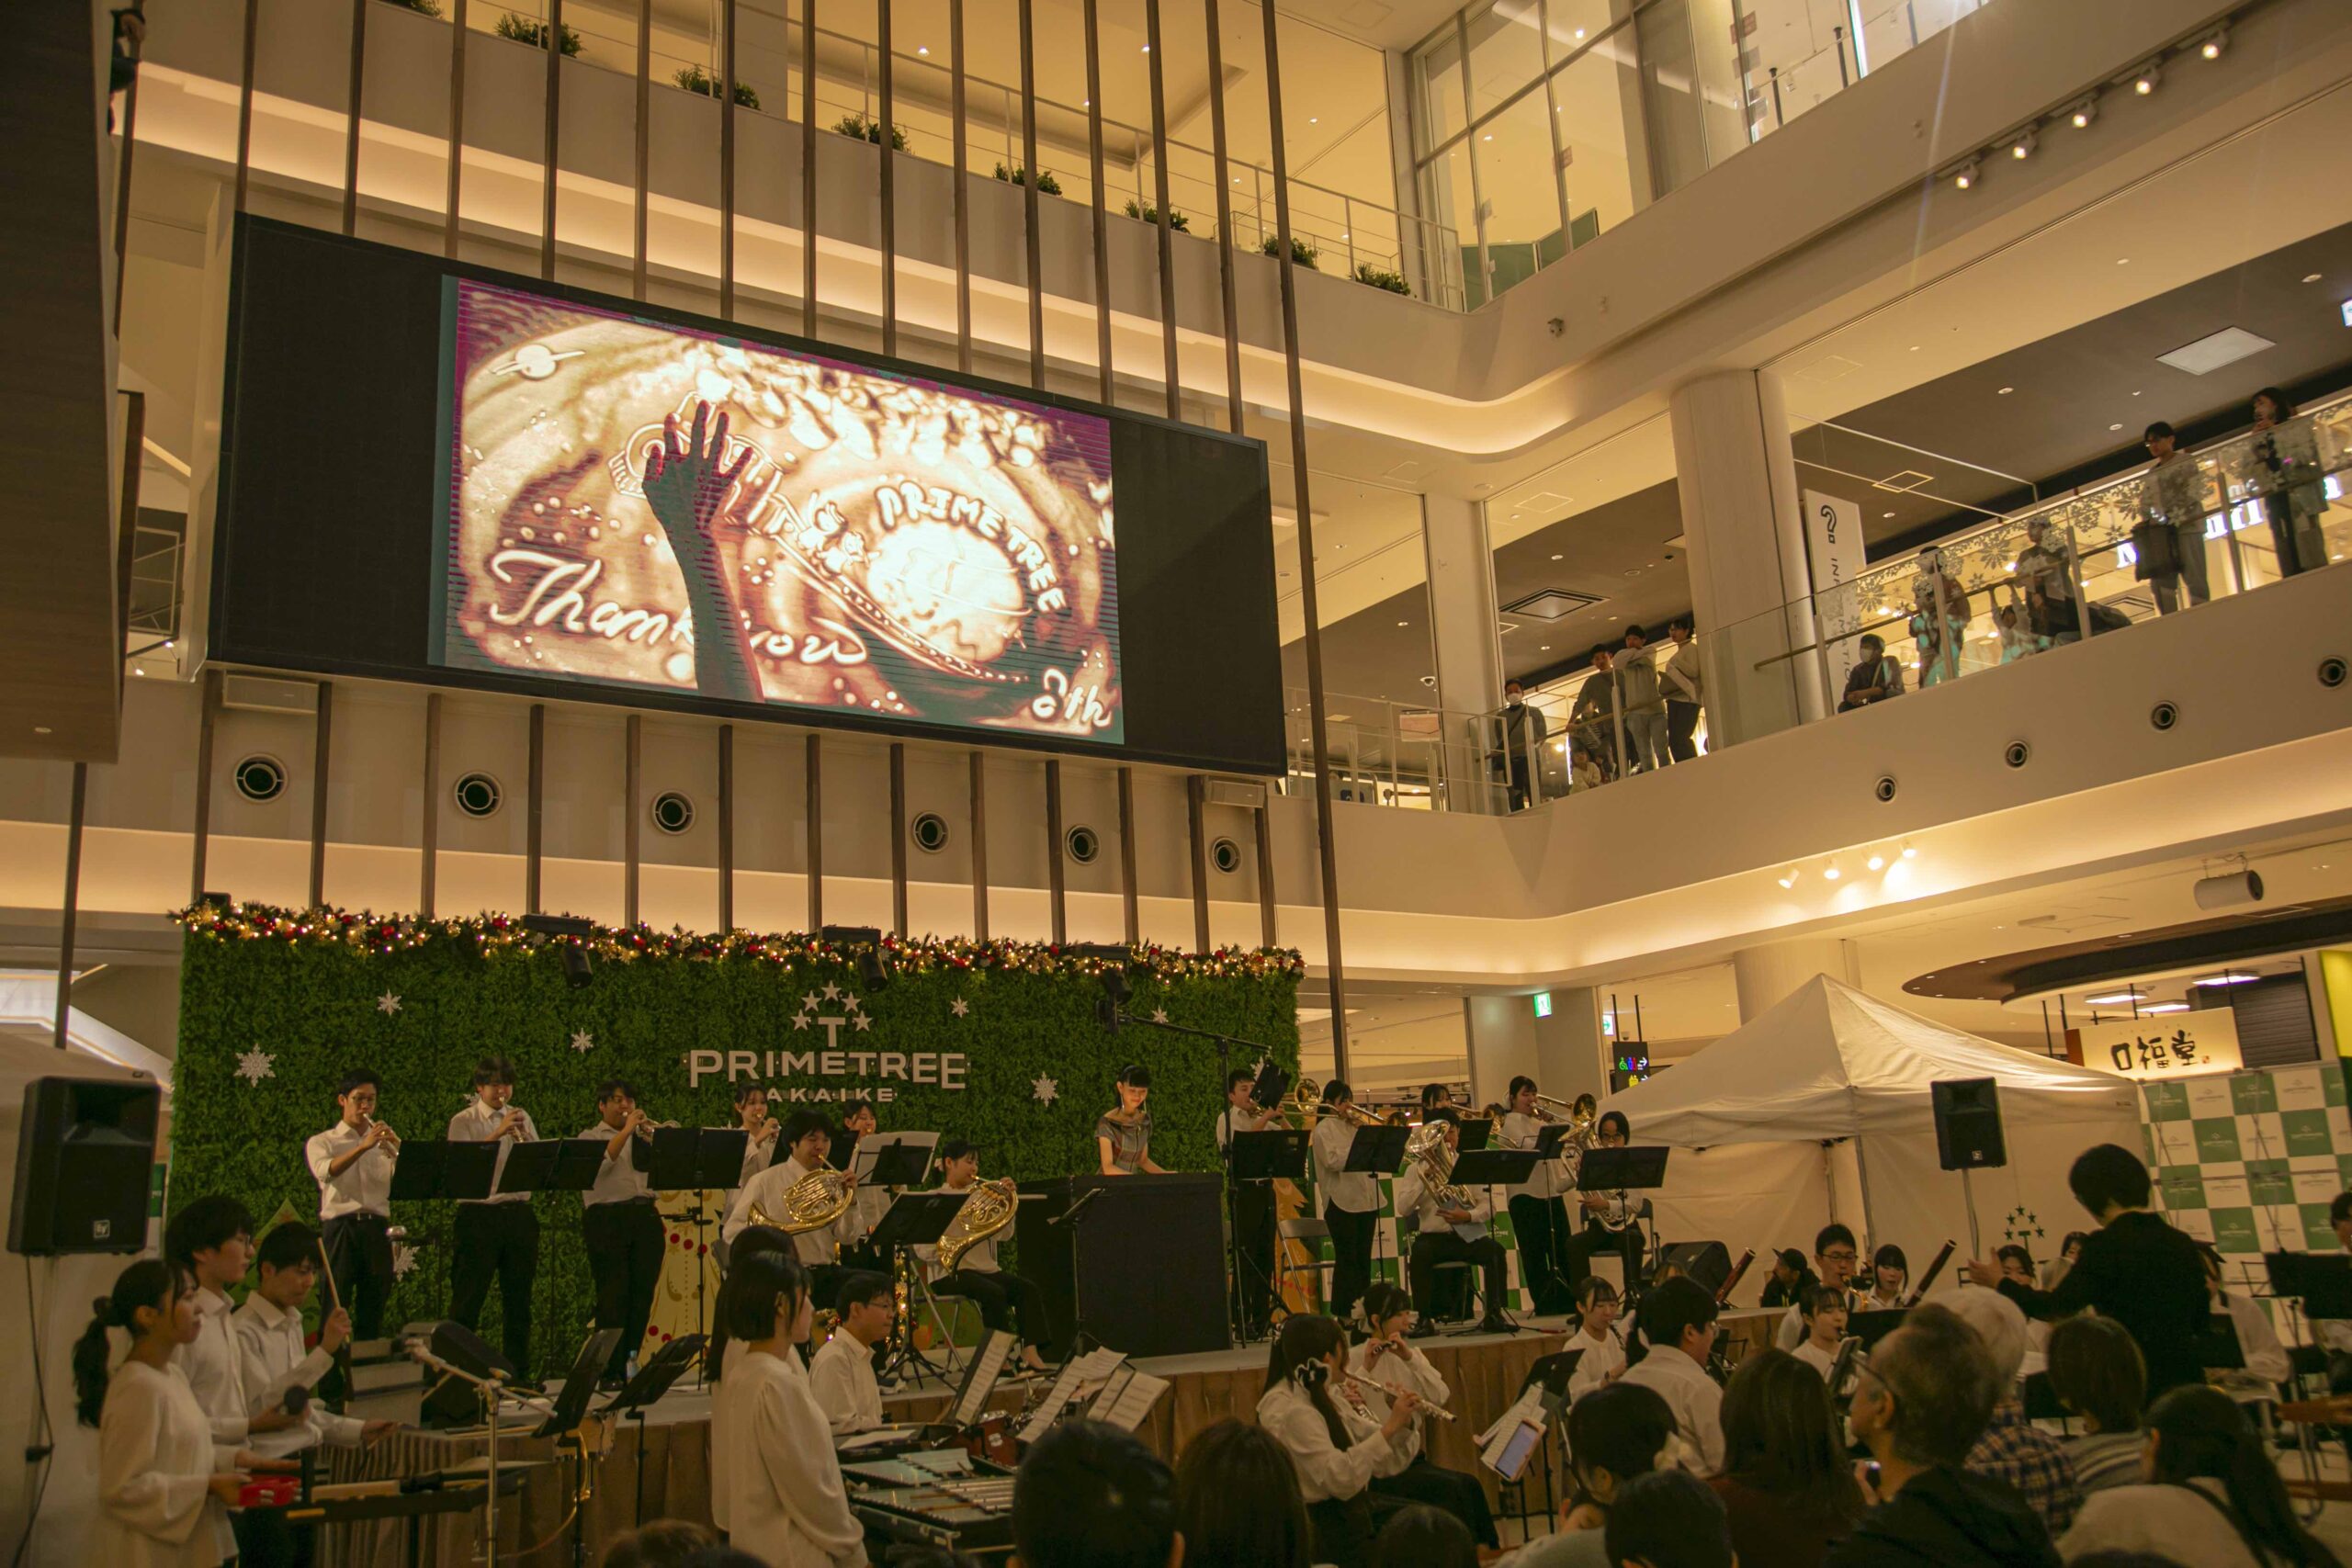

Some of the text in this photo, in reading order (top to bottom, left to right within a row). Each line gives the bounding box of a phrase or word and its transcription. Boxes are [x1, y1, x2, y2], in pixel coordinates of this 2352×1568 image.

[689, 1049, 967, 1089] PRIMETREE
[2110, 1029, 2199, 1071] 口福堂
[766, 1087, 894, 1103] AKAIKE
